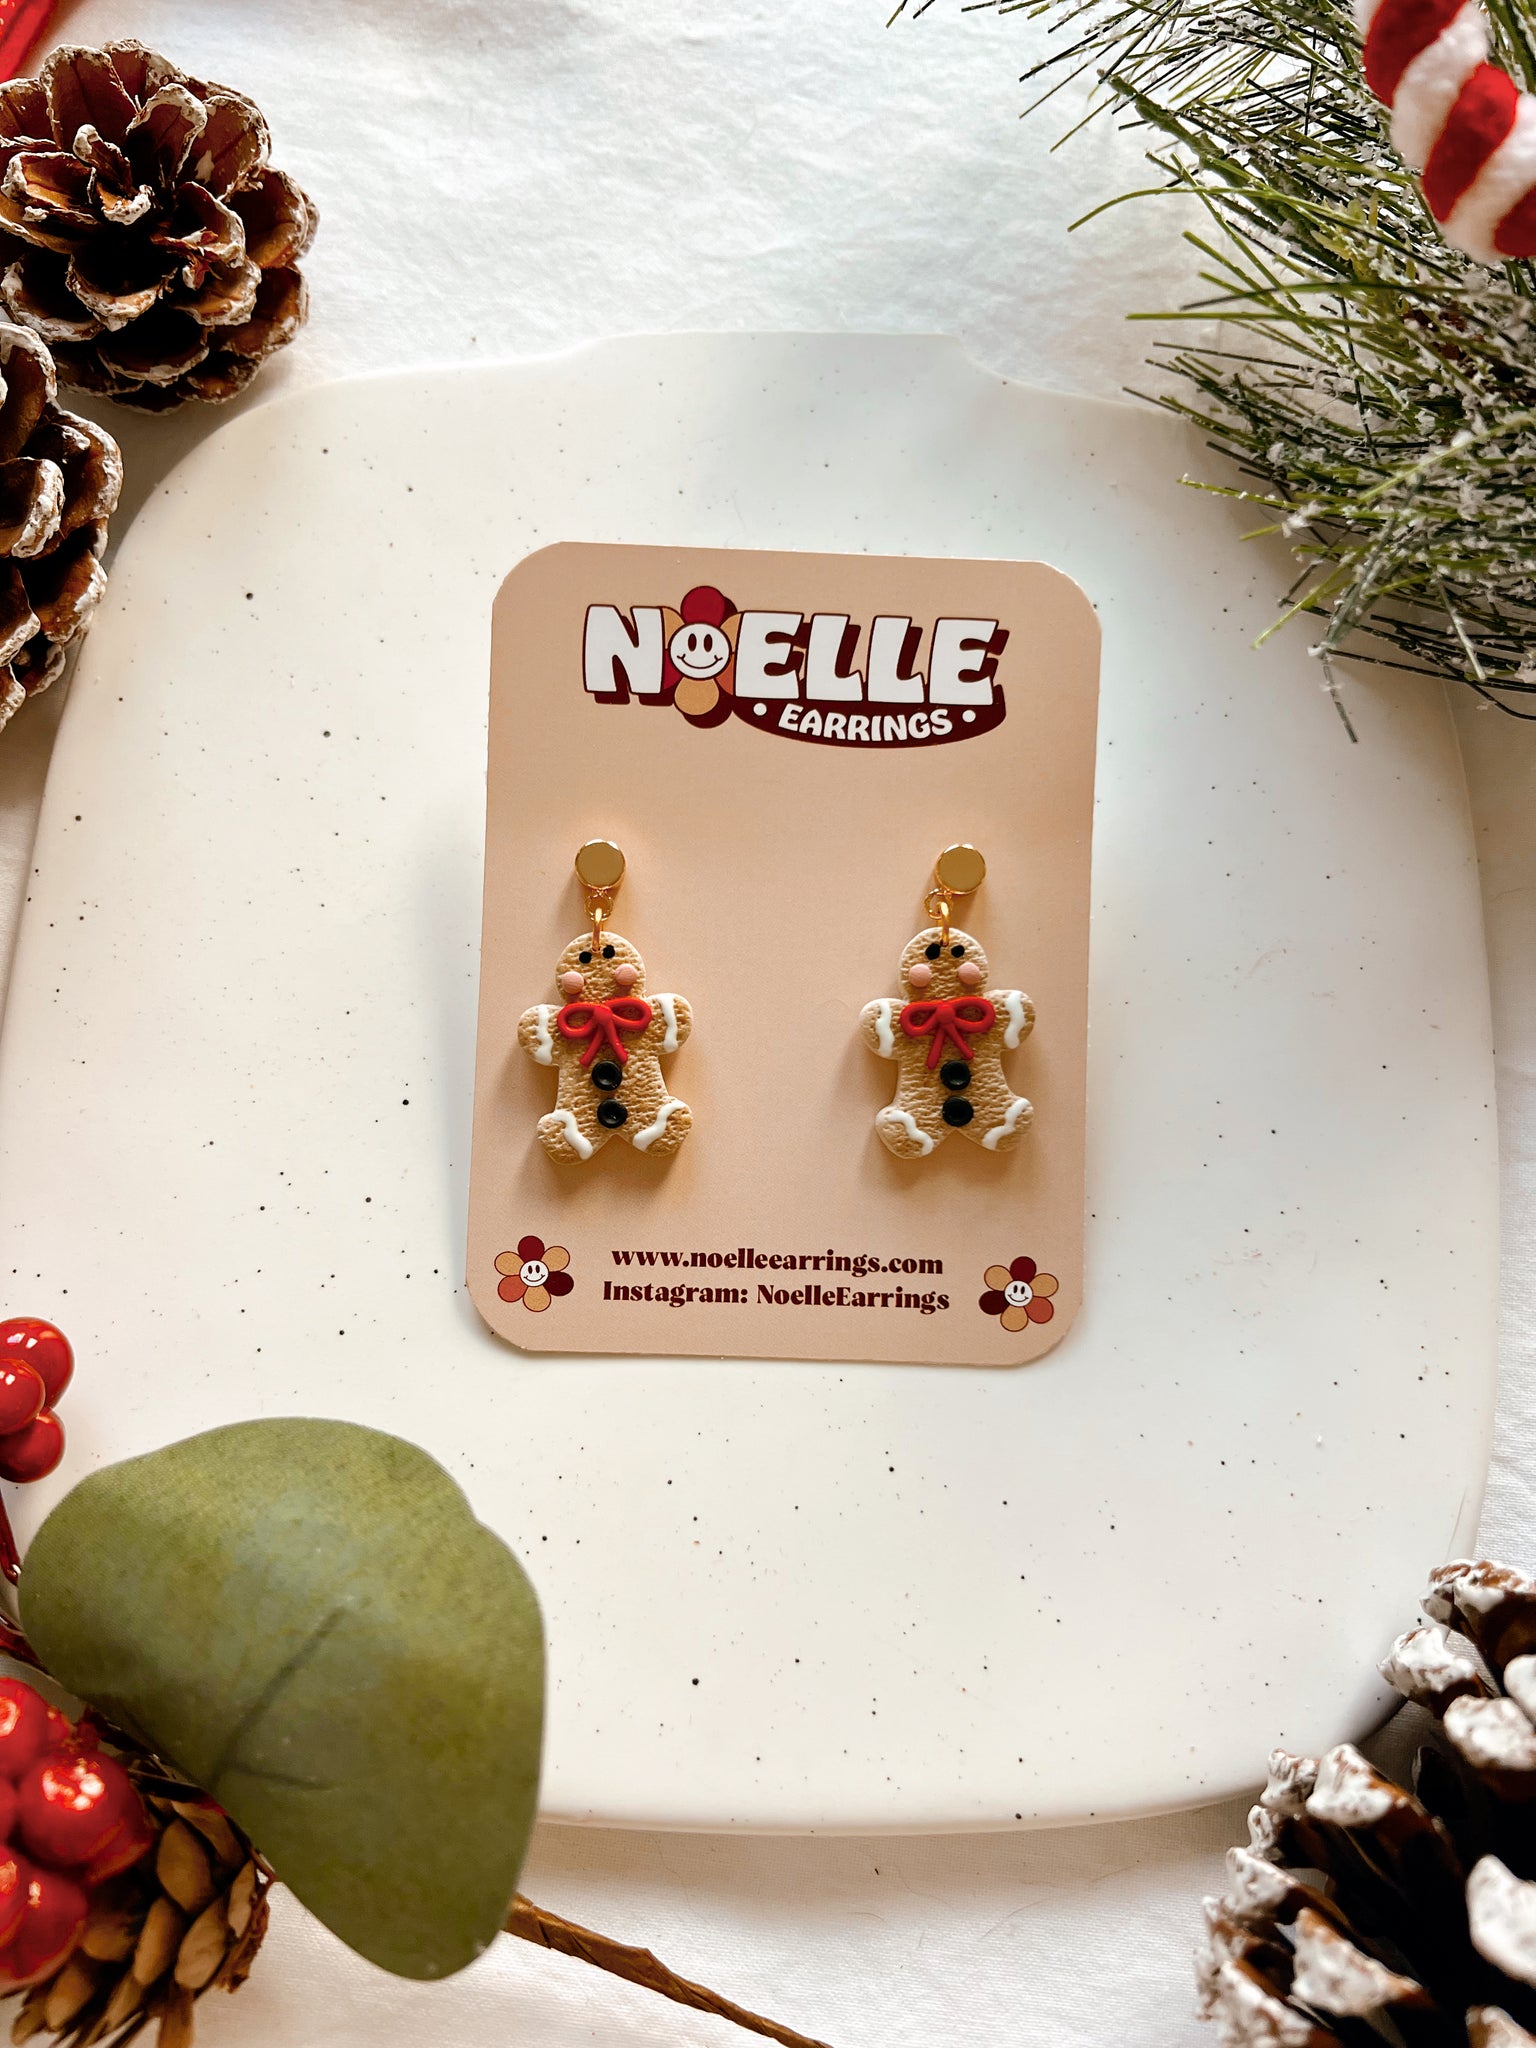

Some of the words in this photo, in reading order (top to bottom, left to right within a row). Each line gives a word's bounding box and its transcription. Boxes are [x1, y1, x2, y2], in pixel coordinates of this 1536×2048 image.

[583, 602, 1009, 707] NOELLE
[778, 703, 953, 742] EARRINGS
[612, 1248, 943, 1277] www.noelleearrings.com
[603, 1281, 748, 1308] Instagram:
[756, 1284, 951, 1315] NoelleEarrings
